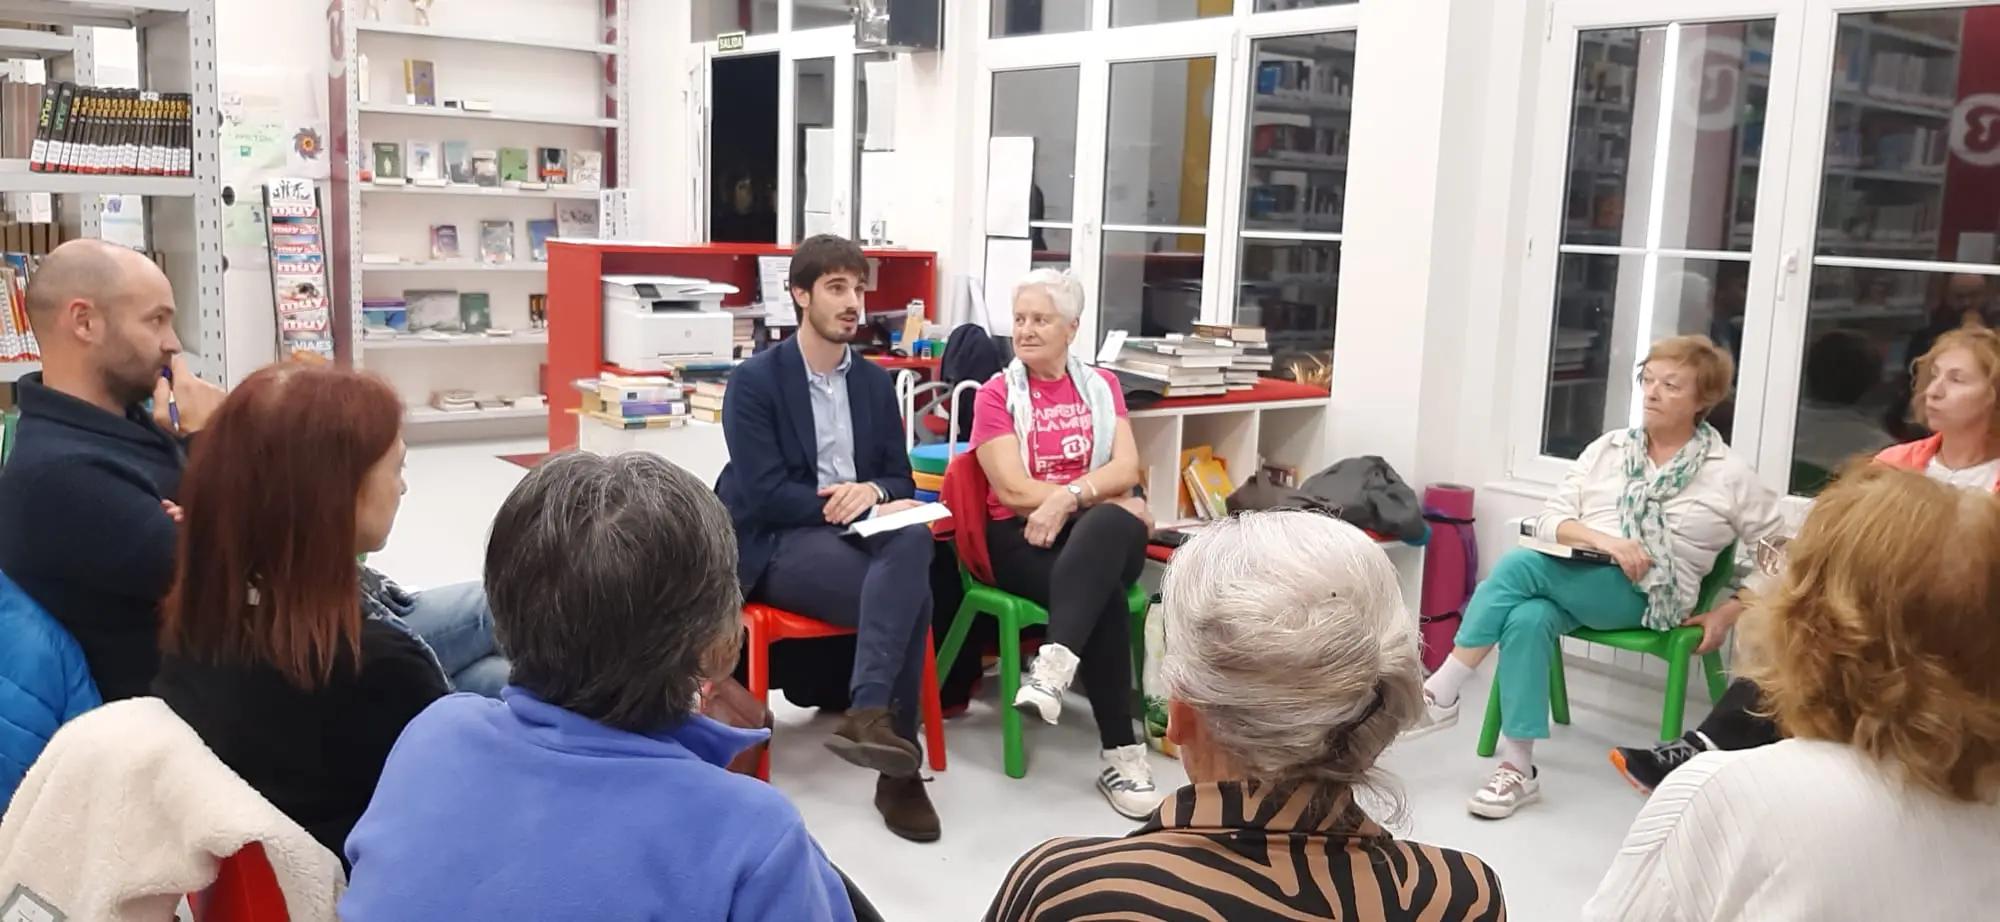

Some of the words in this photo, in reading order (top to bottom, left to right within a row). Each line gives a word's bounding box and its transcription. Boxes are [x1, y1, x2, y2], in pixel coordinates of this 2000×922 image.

[278, 263, 321, 274] muy
[280, 298, 324, 311] muy
[283, 319, 326, 330] muy
